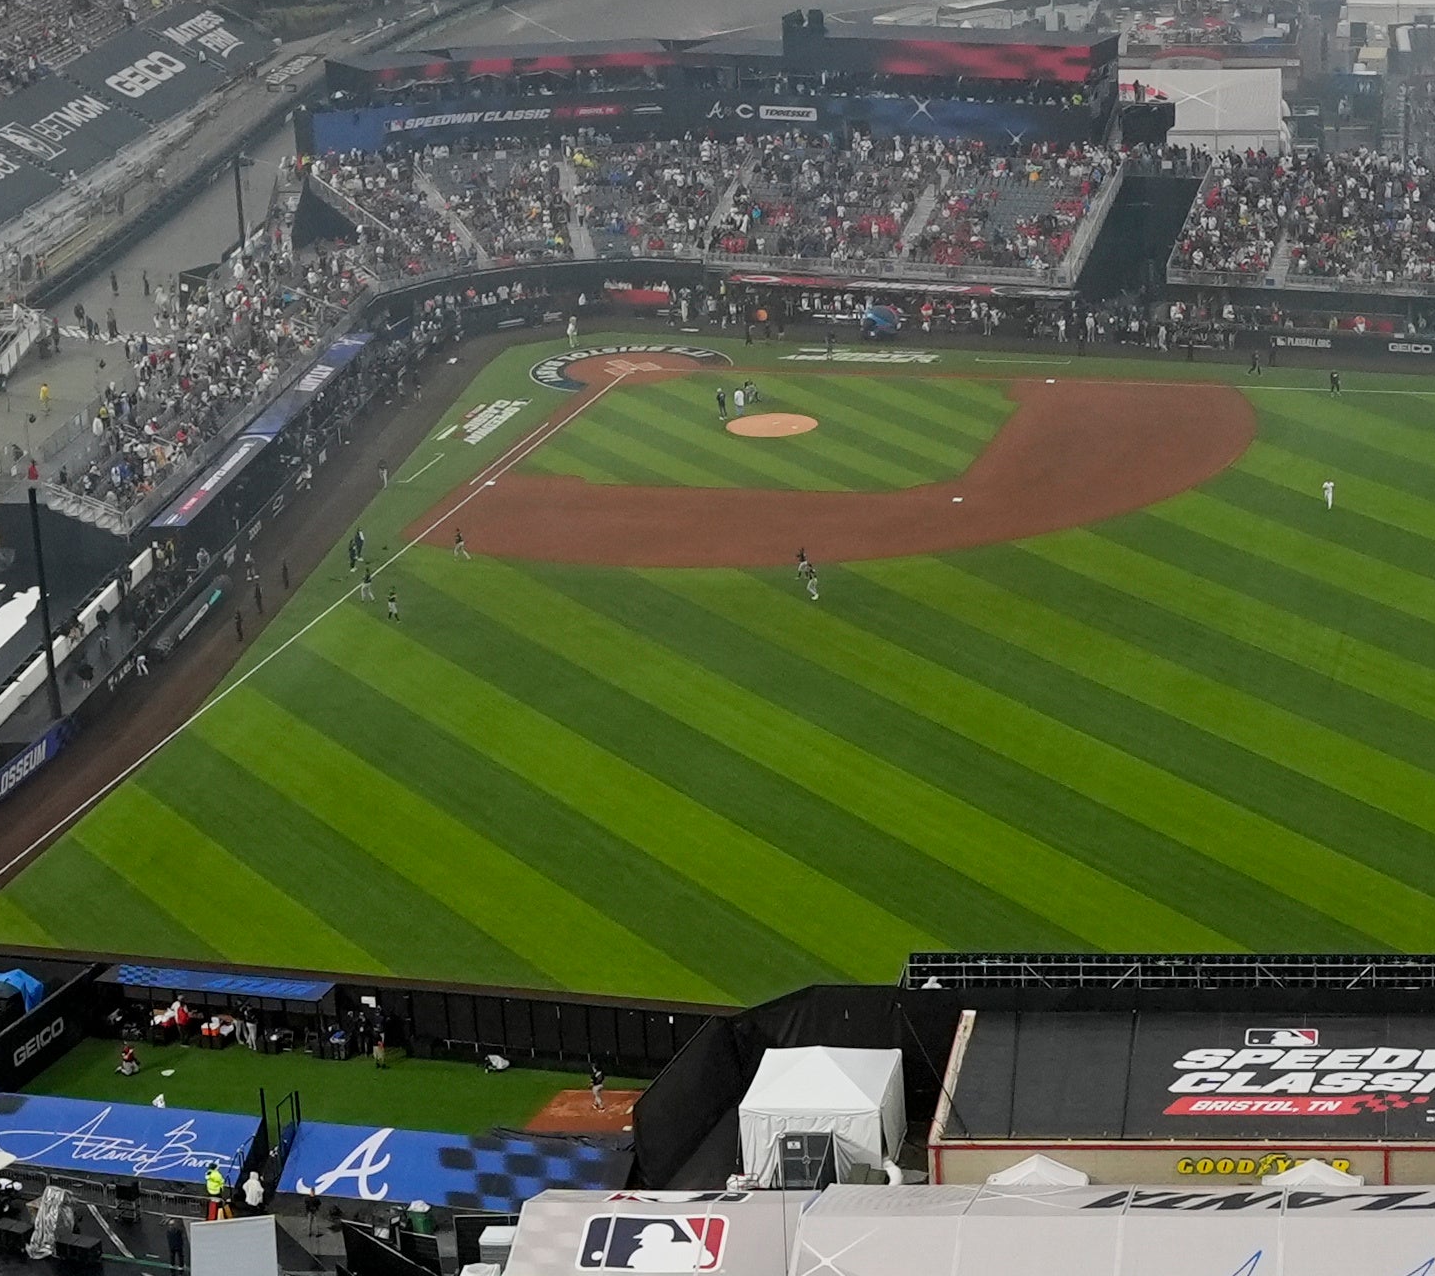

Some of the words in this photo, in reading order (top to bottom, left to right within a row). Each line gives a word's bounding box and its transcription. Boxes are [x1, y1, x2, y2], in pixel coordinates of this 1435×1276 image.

[162, 10, 225, 45] MATTRESS
[197, 26, 240, 54] FIRM
[105, 51, 186, 98] GEICO
[30, 94, 112, 143] BETMGM
[403, 111, 481, 130] SPEEDWAY
[481, 107, 552, 125] CLASSIC
[1388, 342, 1433, 354] GEICO
[13, 1016, 64, 1068] GEICO
[1188, 1098, 1301, 1114] BRISTOL,
[1308, 1099, 1344, 1113] TN
[1176, 1157, 1351, 1175] GOODYR
